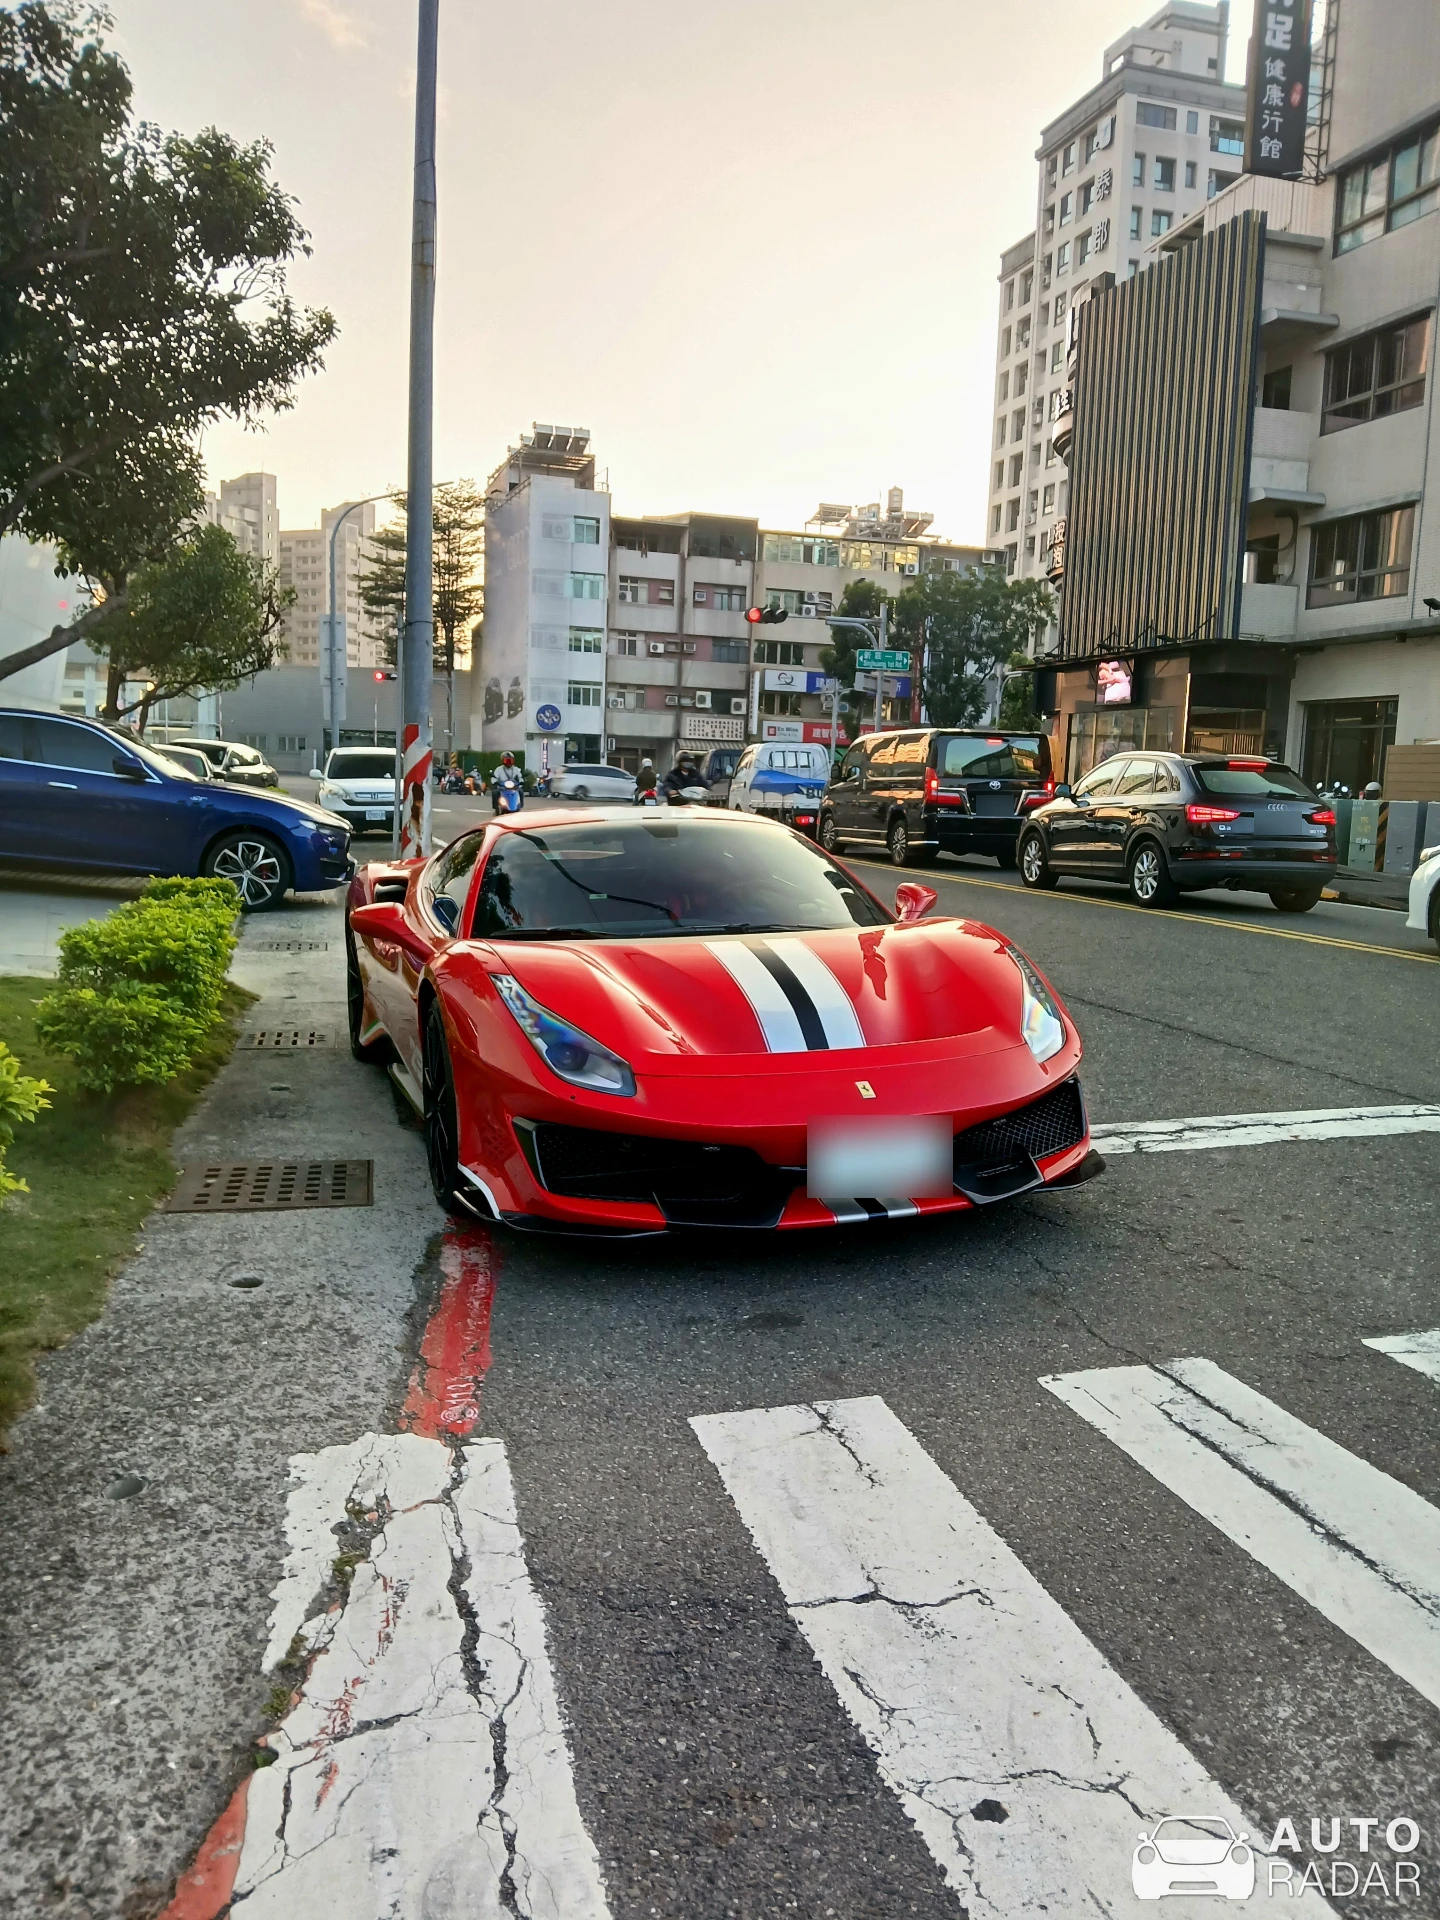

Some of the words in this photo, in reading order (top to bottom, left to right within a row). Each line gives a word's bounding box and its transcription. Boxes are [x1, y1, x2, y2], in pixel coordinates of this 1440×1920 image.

[1260, 0, 1294, 159] 足健康行館
